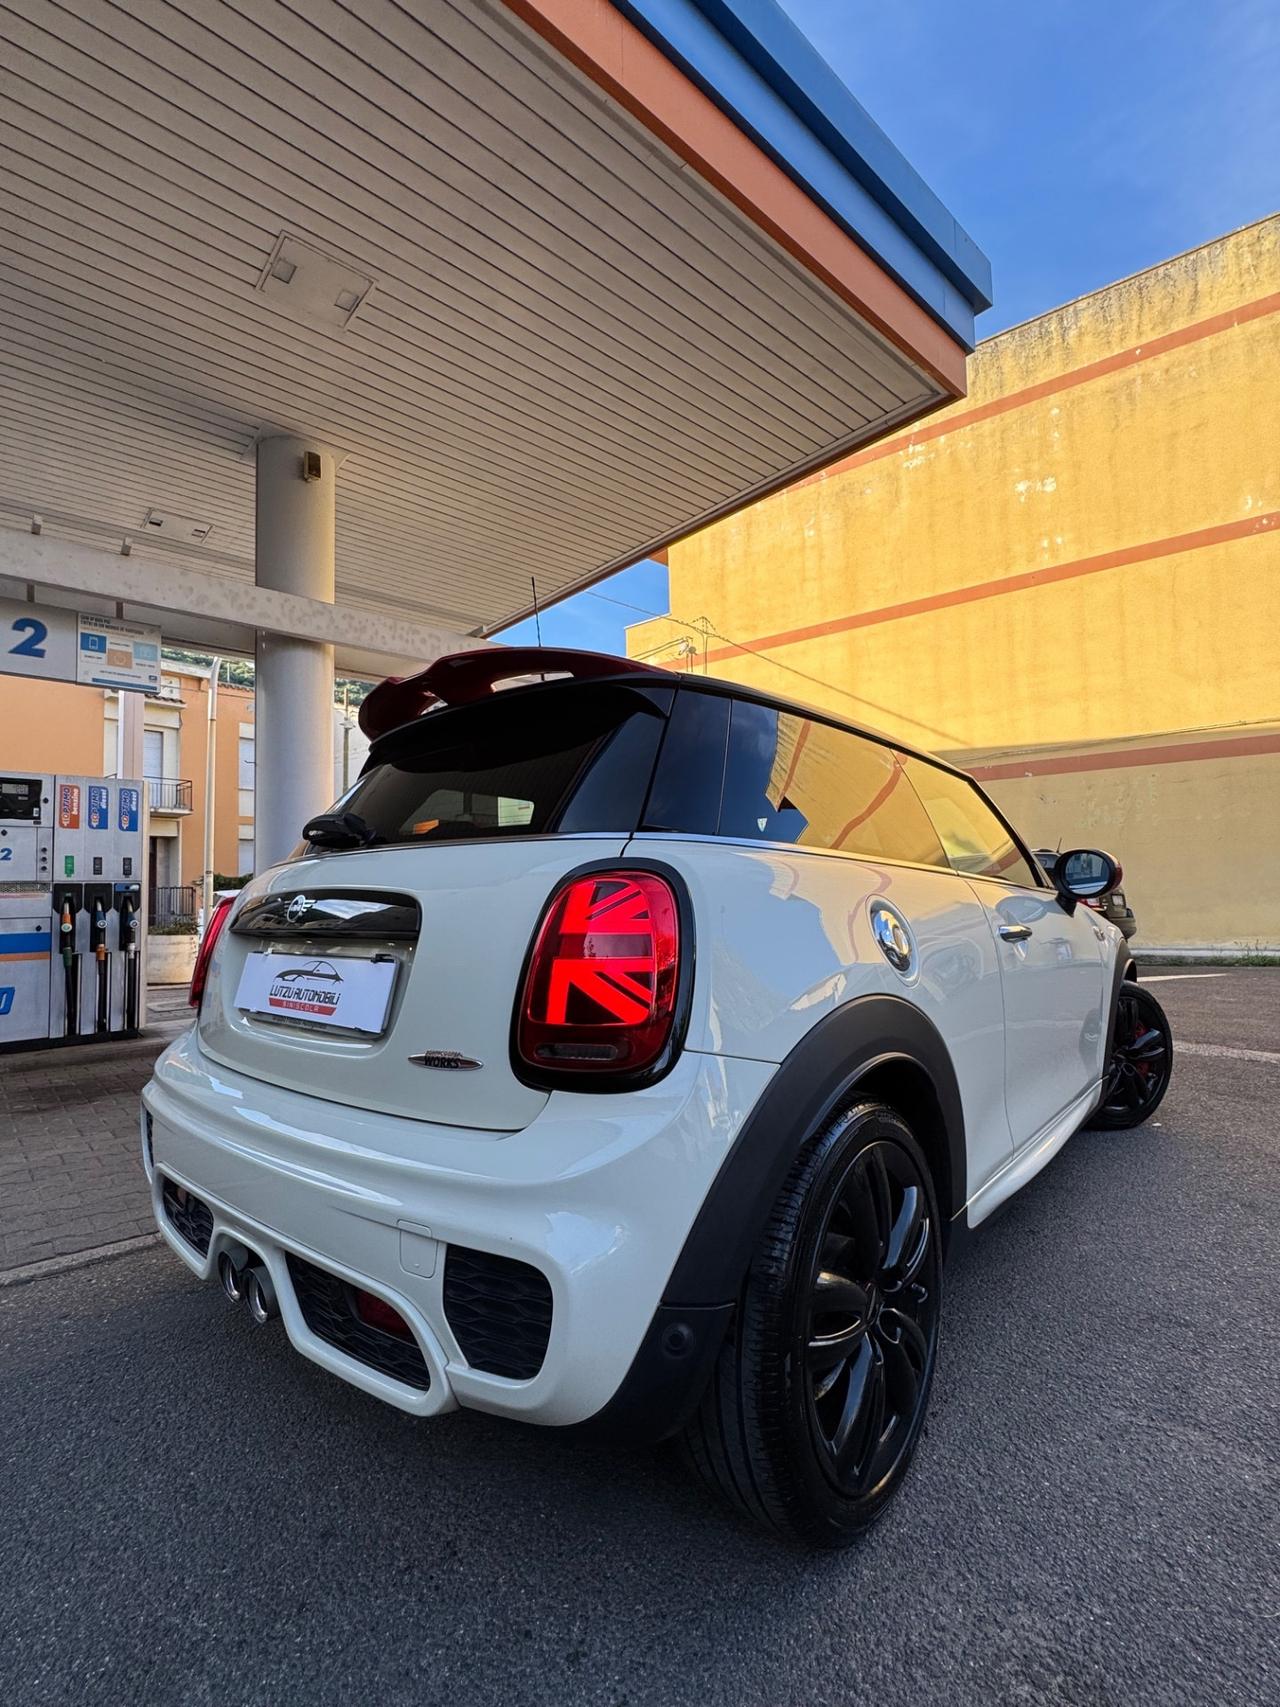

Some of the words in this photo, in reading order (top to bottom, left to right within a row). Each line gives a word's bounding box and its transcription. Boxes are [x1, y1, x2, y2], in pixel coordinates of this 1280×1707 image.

[8, 617, 48, 658] 2
[62, 787, 71, 819] OPTIMO
[71, 788, 79, 815] benzina
[91, 787, 100, 820] OPTIMO
[121, 789, 130, 821] OPTIMO
[0, 847, 13, 861] 2
[269, 985, 295, 999] LUTZU
[424, 1055, 460, 1068] WORKS
